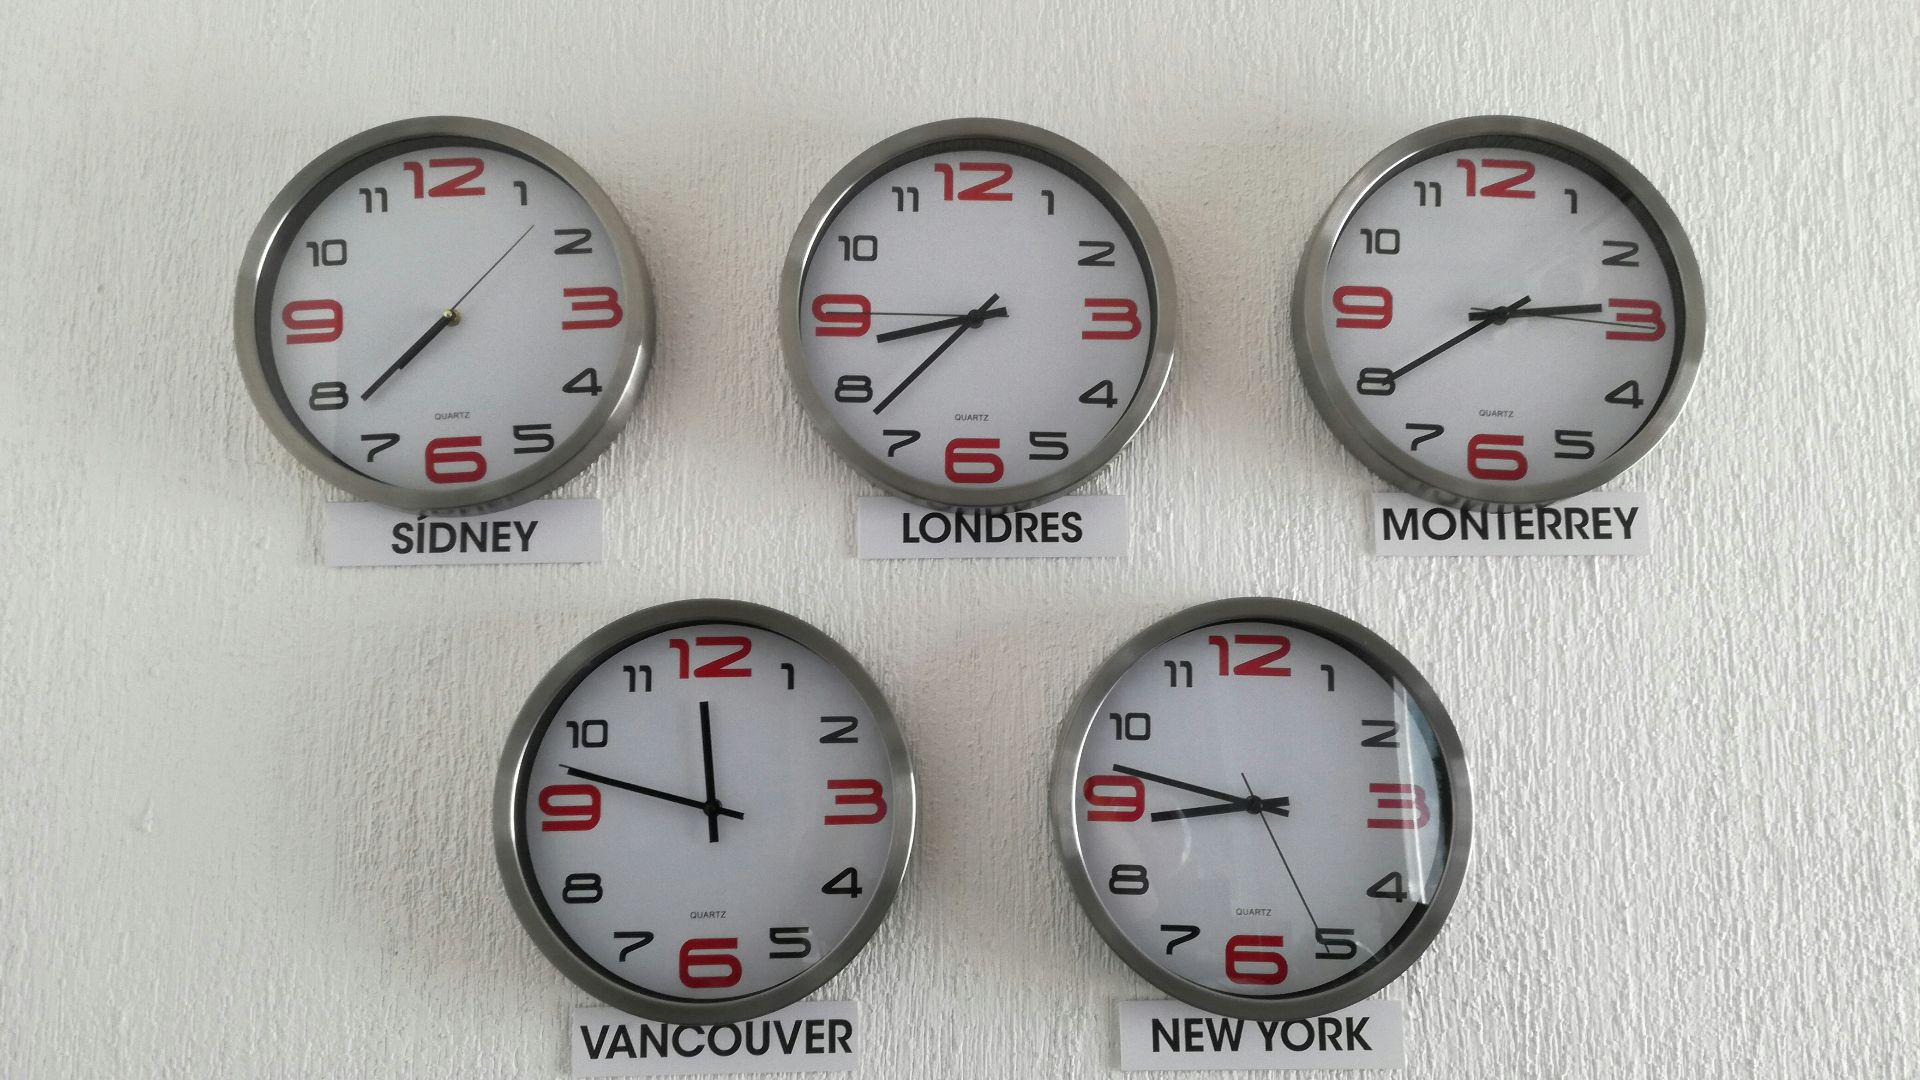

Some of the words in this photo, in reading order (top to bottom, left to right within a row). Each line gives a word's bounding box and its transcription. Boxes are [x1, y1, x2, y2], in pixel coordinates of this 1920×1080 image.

[403, 157, 486, 199] 12
[513, 180, 528, 205] 1
[934, 162, 1013, 201] 12
[1457, 158, 1536, 199] 12
[359, 187, 388, 213] 11
[892, 186, 919, 212] 11
[1041, 189, 1054, 215] 1
[1414, 180, 1442, 207] 11
[1564, 188, 1578, 214] 1
[306, 239, 347, 266] 10
[554, 228, 593, 255] 2
[838, 235, 878, 262] 10
[1078, 241, 1115, 266] 2
[1360, 228, 1400, 255] 10
[1602, 240, 1640, 266] 2
[282, 299, 343, 344] 9
[562, 286, 623, 330] 3
[812, 294, 871, 337] 9
[1082, 298, 1142, 340] 3
[1332, 286, 1393, 329] 9
[1606, 298, 1666, 341] 3
[309, 381, 349, 411] 8
[562, 367, 602, 396] 4
[835, 375, 873, 403] 8
[1079, 380, 1118, 408] 4
[1357, 367, 1396, 396] 8
[1604, 380, 1643, 409] 4
[434, 411, 470, 420] QUARTZ
[954, 413, 989, 422] QUARTZ
[1478, 409, 1514, 418] QUARTZ
[361, 433, 400, 462] 7
[513, 424, 554, 454] 5
[883, 430, 920, 457] 7
[1029, 431, 1069, 460] 5
[1405, 423, 1445, 451] 7
[1554, 430, 1595, 460] 5
[425, 436, 487, 484] 6
[945, 437, 1004, 484] 6
[1467, 433, 1528, 481] 6
[391, 514, 538, 554] SÍDNEY
[903, 511, 1082, 543] LONDRES
[1383, 506, 1639, 541] MONTERREY
[669, 636, 752, 679] 12
[1208, 634, 1292, 676] 12
[623, 665, 652, 692] 11
[781, 662, 795, 689] 1
[1164, 660, 1193, 687] 11
[1321, 664, 1335, 692] 1
[566, 719, 608, 748] 10
[819, 716, 859, 743] 2
[1110, 712, 1151, 741] 10
[1361, 719, 1400, 748] 2
[538, 784, 601, 832] 9
[824, 778, 888, 825] 3
[1083, 775, 1145, 822] 9
[1367, 783, 1431, 829] 3
[562, 873, 603, 904] 8
[822, 867, 862, 898] 4
[1109, 864, 1149, 895] 8
[1367, 872, 1408, 903] 4
[690, 911, 726, 919] QUARTZ
[1236, 908, 1272, 917] QUARTZ
[614, 931, 654, 962] 7
[769, 927, 812, 959] 5
[1160, 924, 1200, 955] 7
[1315, 928, 1357, 960] 5
[679, 937, 742, 989] 6
[1225, 935, 1288, 985] 6
[580, 1019, 853, 1060] VANCOUVER
[1152, 1018, 1244, 1053] NEW
[1257, 1017, 1373, 1051] YORK
